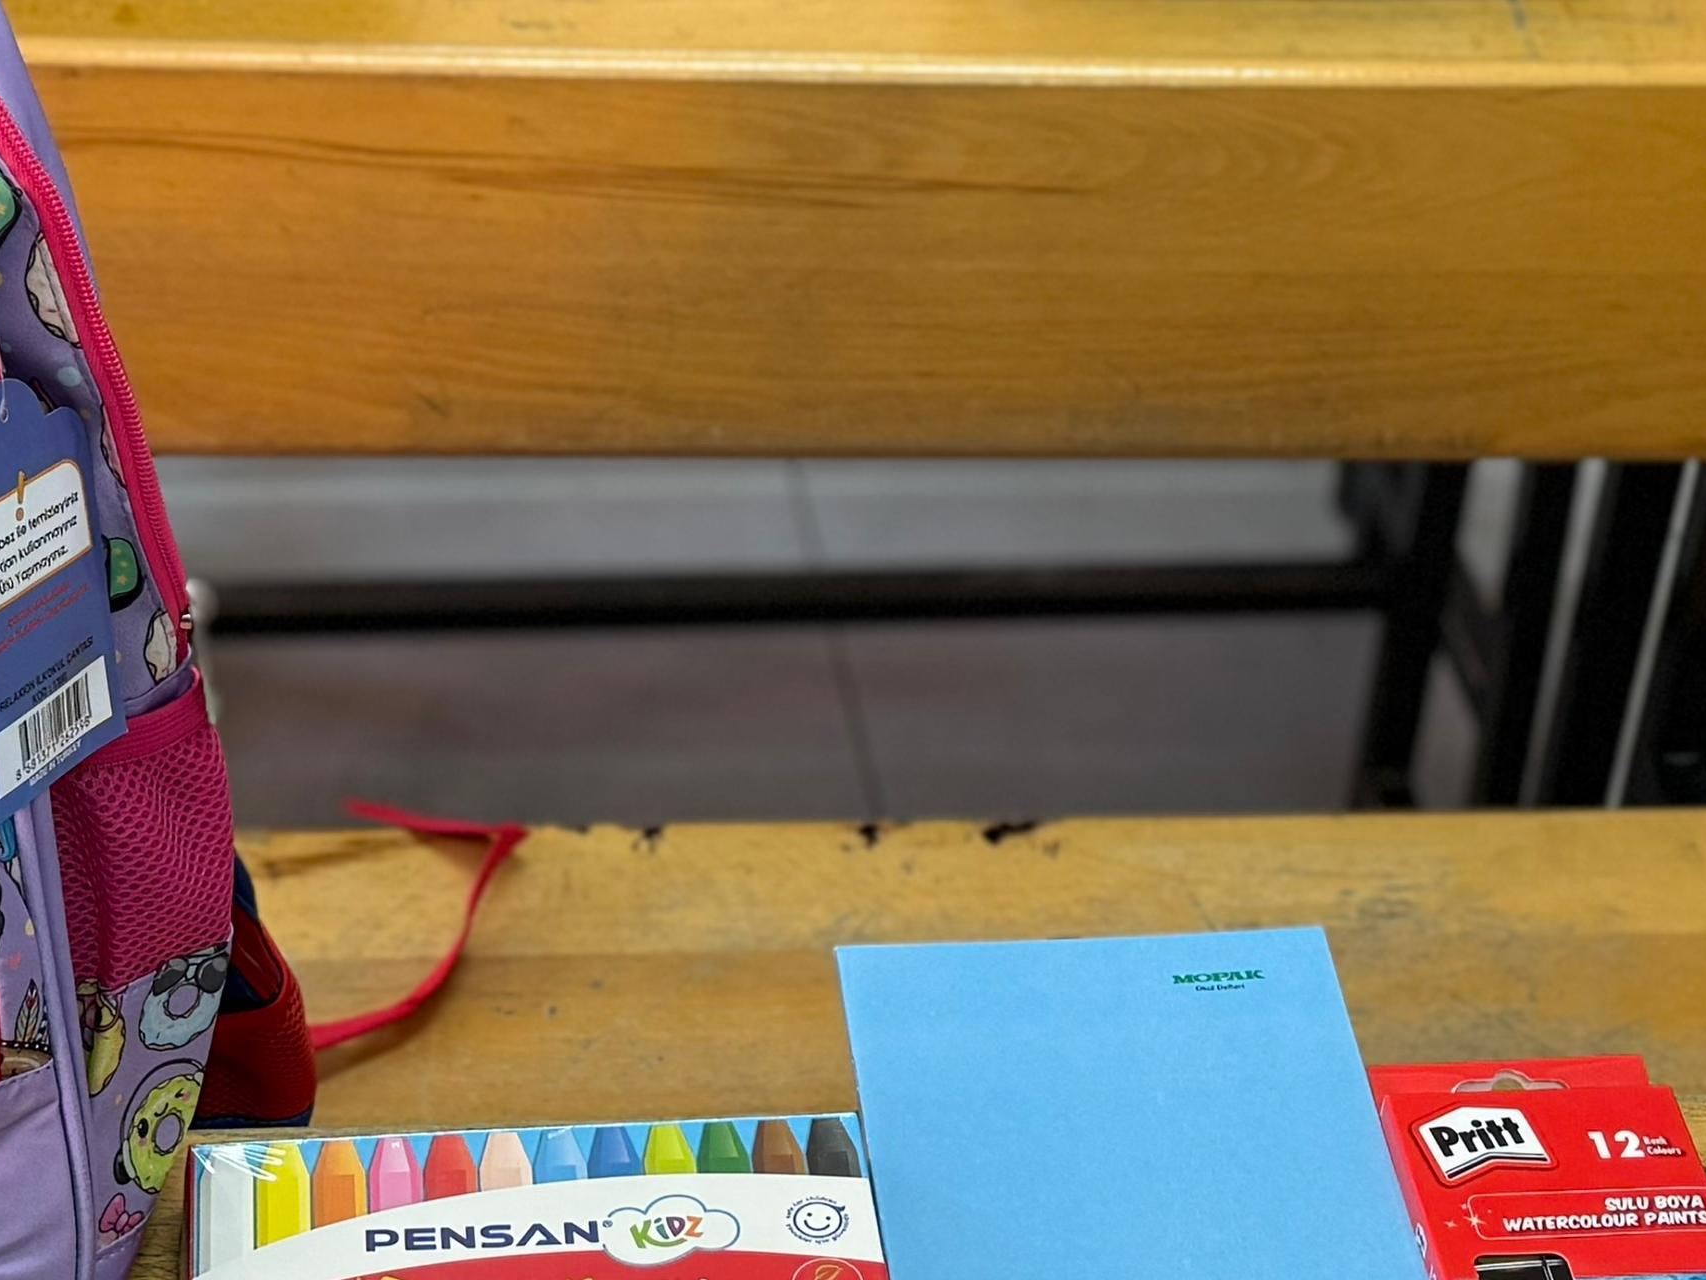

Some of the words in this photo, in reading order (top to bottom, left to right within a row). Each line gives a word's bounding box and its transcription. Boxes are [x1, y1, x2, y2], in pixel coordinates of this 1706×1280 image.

[1172, 970, 1265, 984] MOPAK
[1431, 1115, 1525, 1158] Pritt
[1587, 1130, 1646, 1159] 12
[1647, 1146, 1682, 1156] Colours
[1605, 1196, 1649, 1212] SULU
[1653, 1195, 1705, 1210] BOYA
[1503, 1214, 1639, 1232] WATERCOLOUR
[365, 1220, 599, 1252] PENSAN
